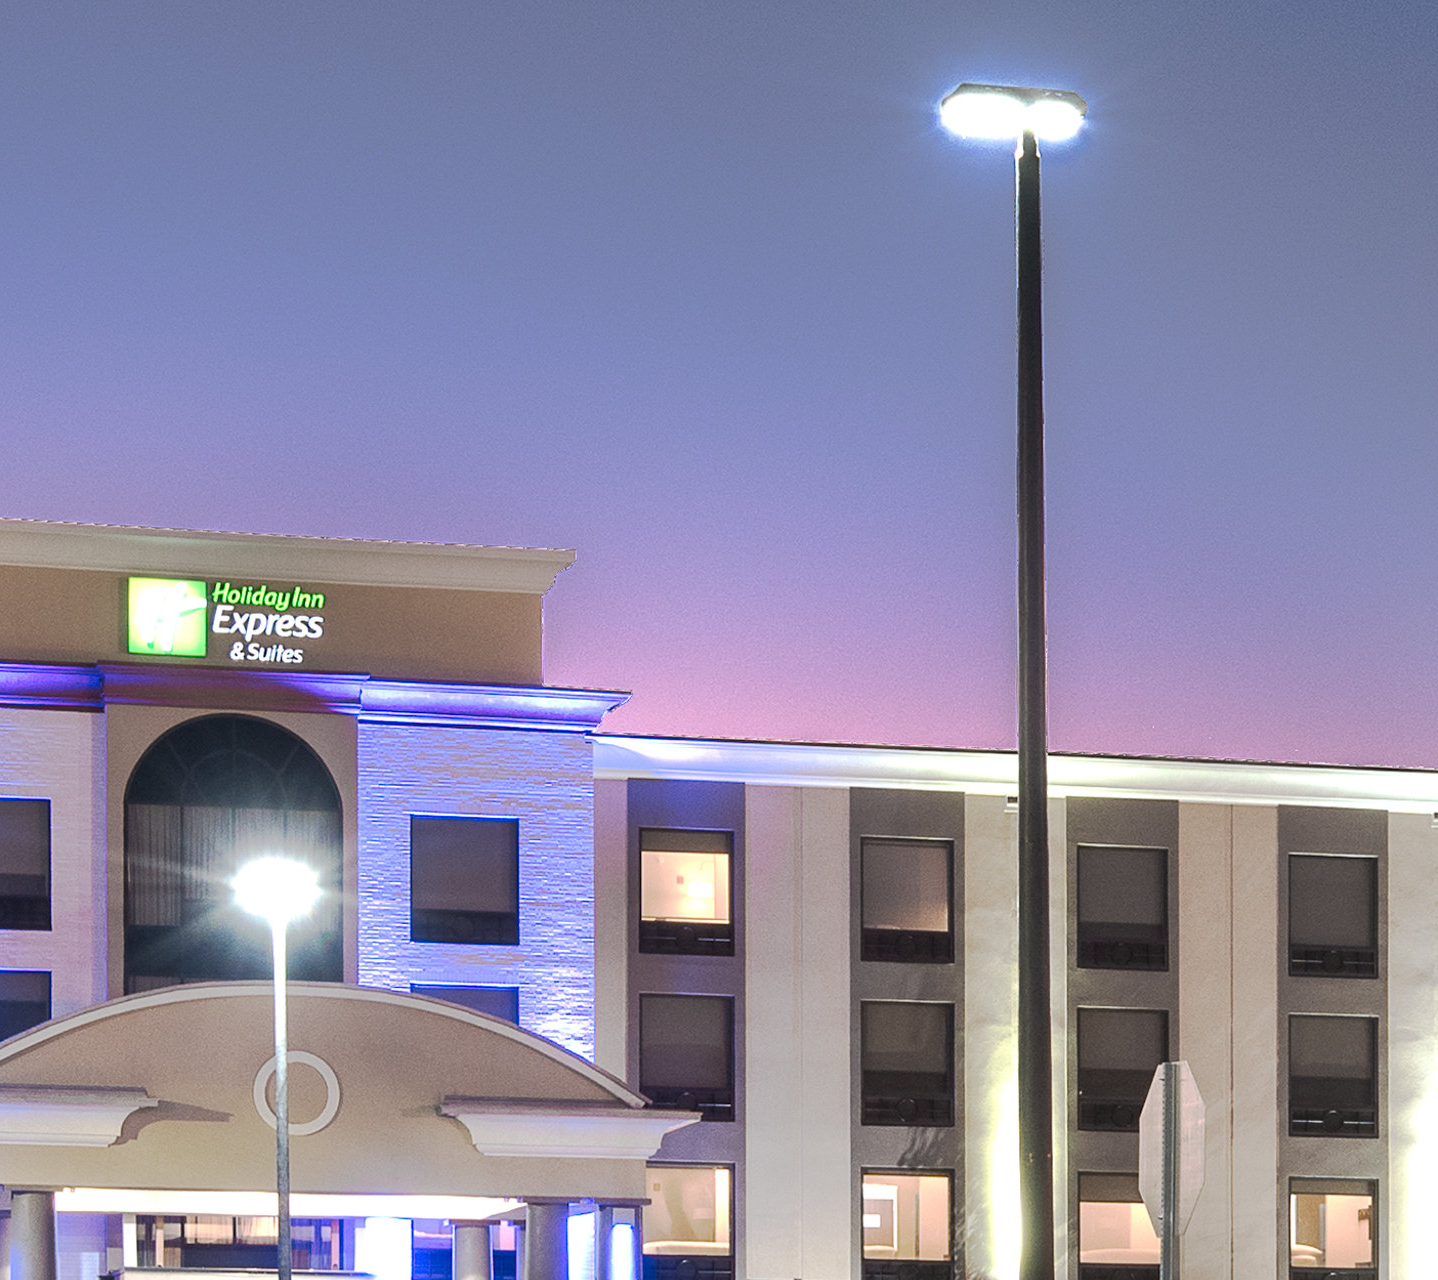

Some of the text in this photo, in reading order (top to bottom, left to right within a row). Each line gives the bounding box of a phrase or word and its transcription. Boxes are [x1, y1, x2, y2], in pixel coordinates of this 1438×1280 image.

[211, 581, 325, 612] Holiday Inn
[211, 604, 325, 643] Express
[229, 640, 304, 664] & Suites
